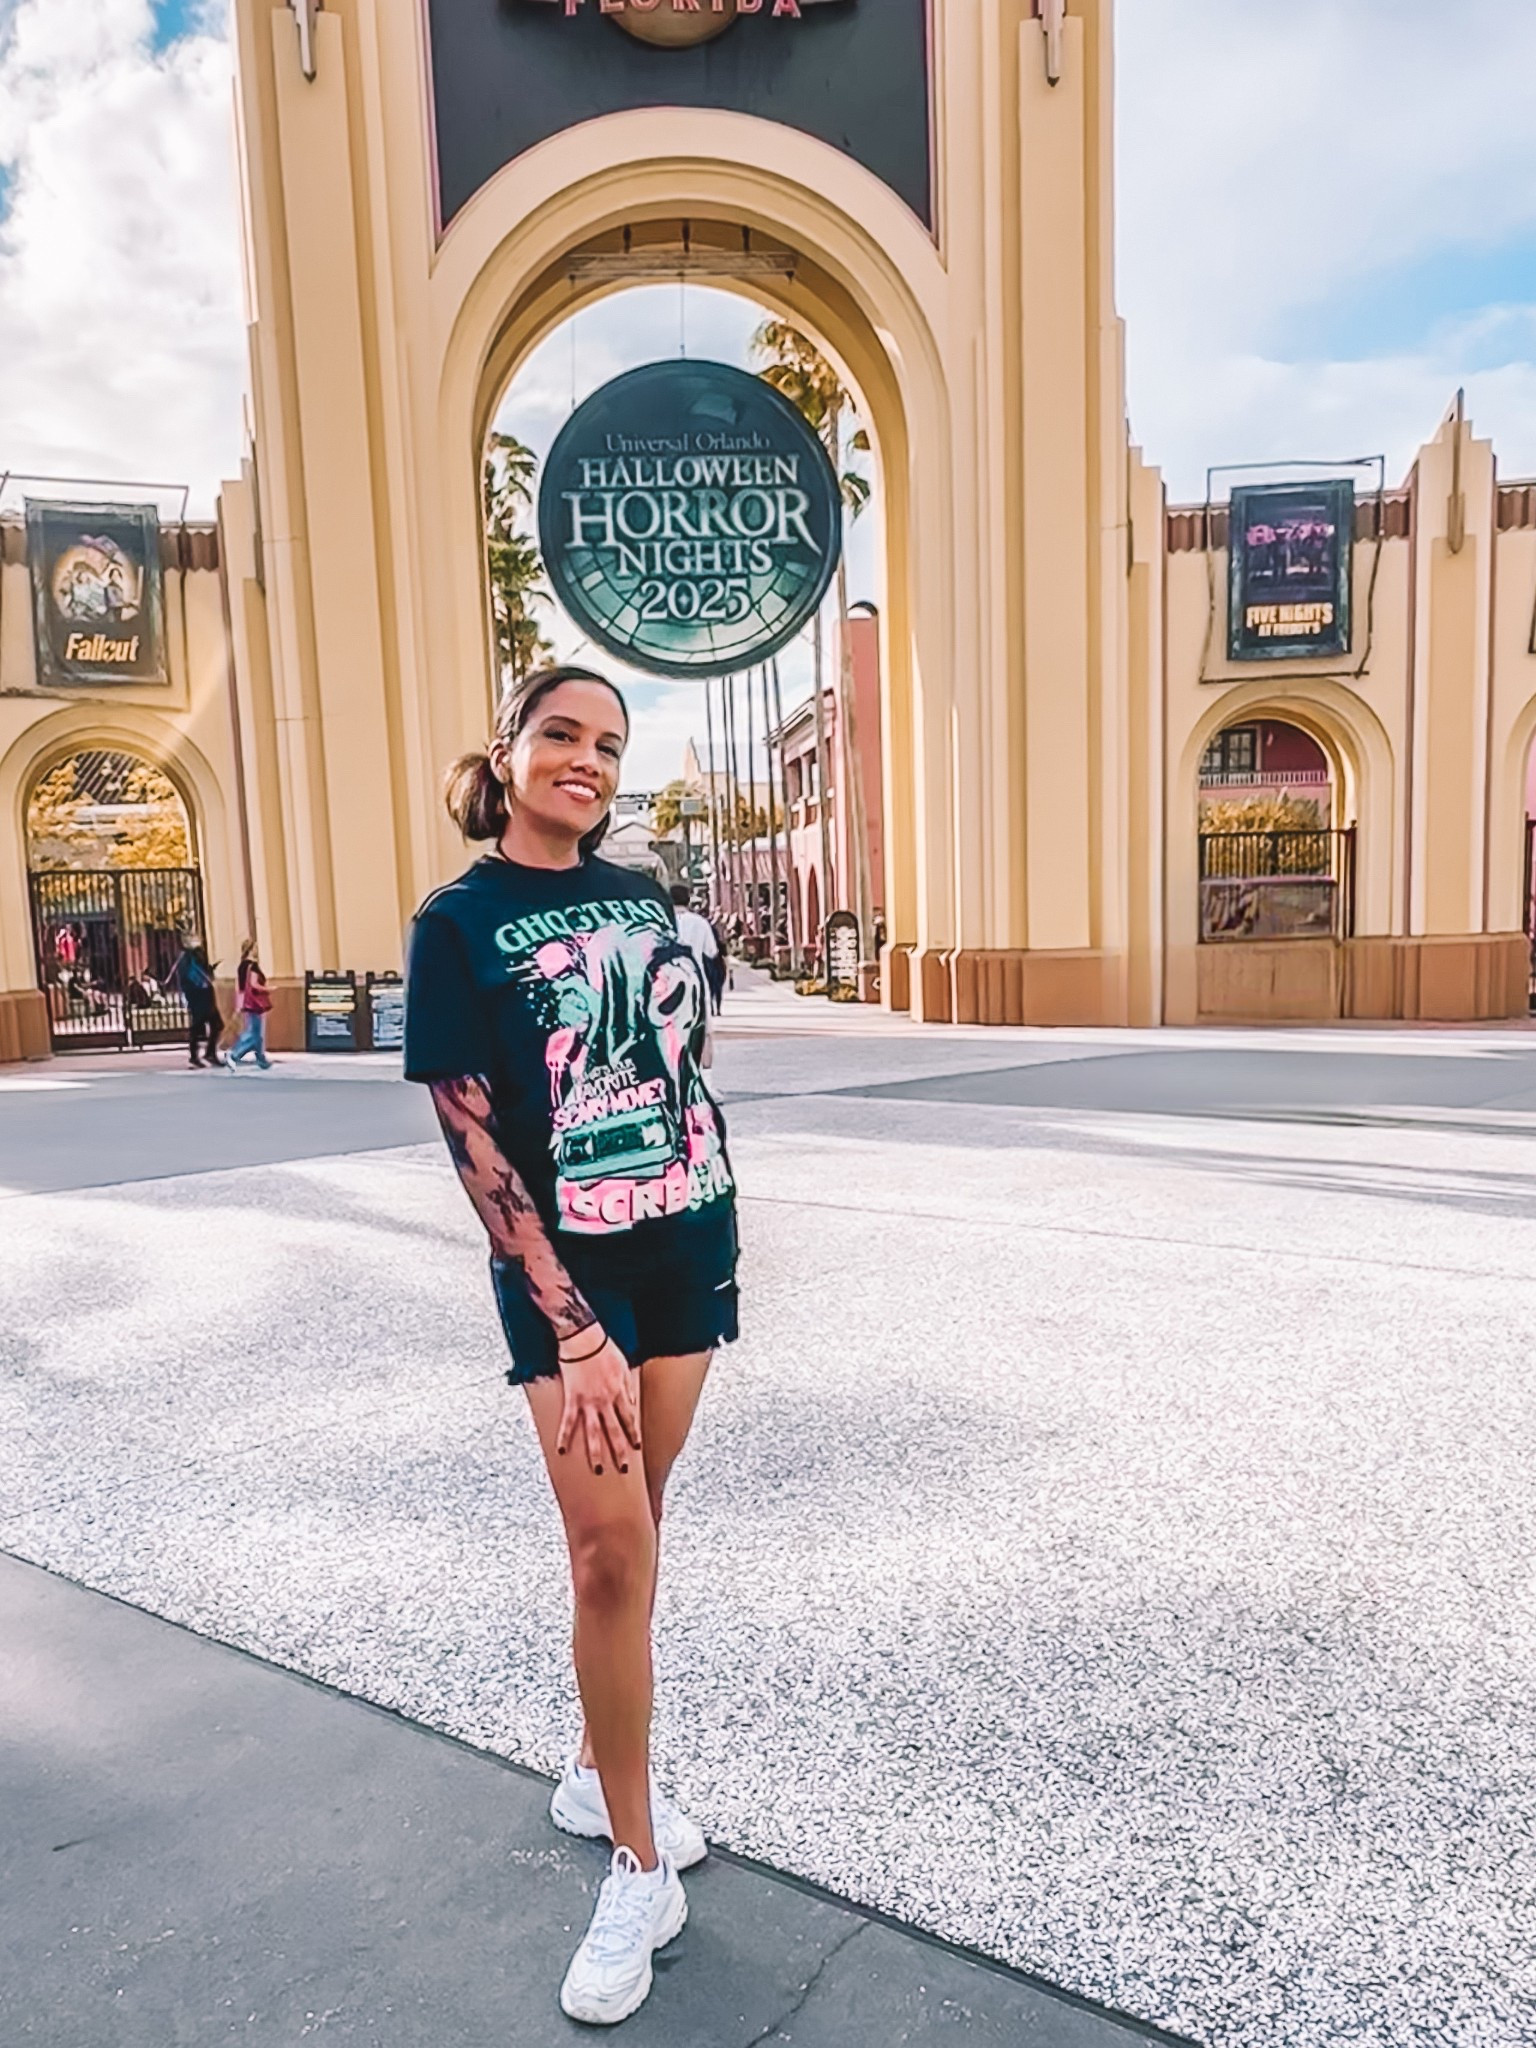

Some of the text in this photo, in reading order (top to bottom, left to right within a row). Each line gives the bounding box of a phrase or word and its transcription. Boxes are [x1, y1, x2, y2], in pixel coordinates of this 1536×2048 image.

[605, 430, 770, 452] Universal Orlando
[578, 452, 800, 489] HALLOWEEN
[561, 488, 822, 556] HORROR
[615, 540, 773, 577] NIGHTS
[640, 578, 752, 621] 2025
[1246, 602, 1334, 629] FIVE NIGHTS
[65, 632, 140, 663] Fallout
